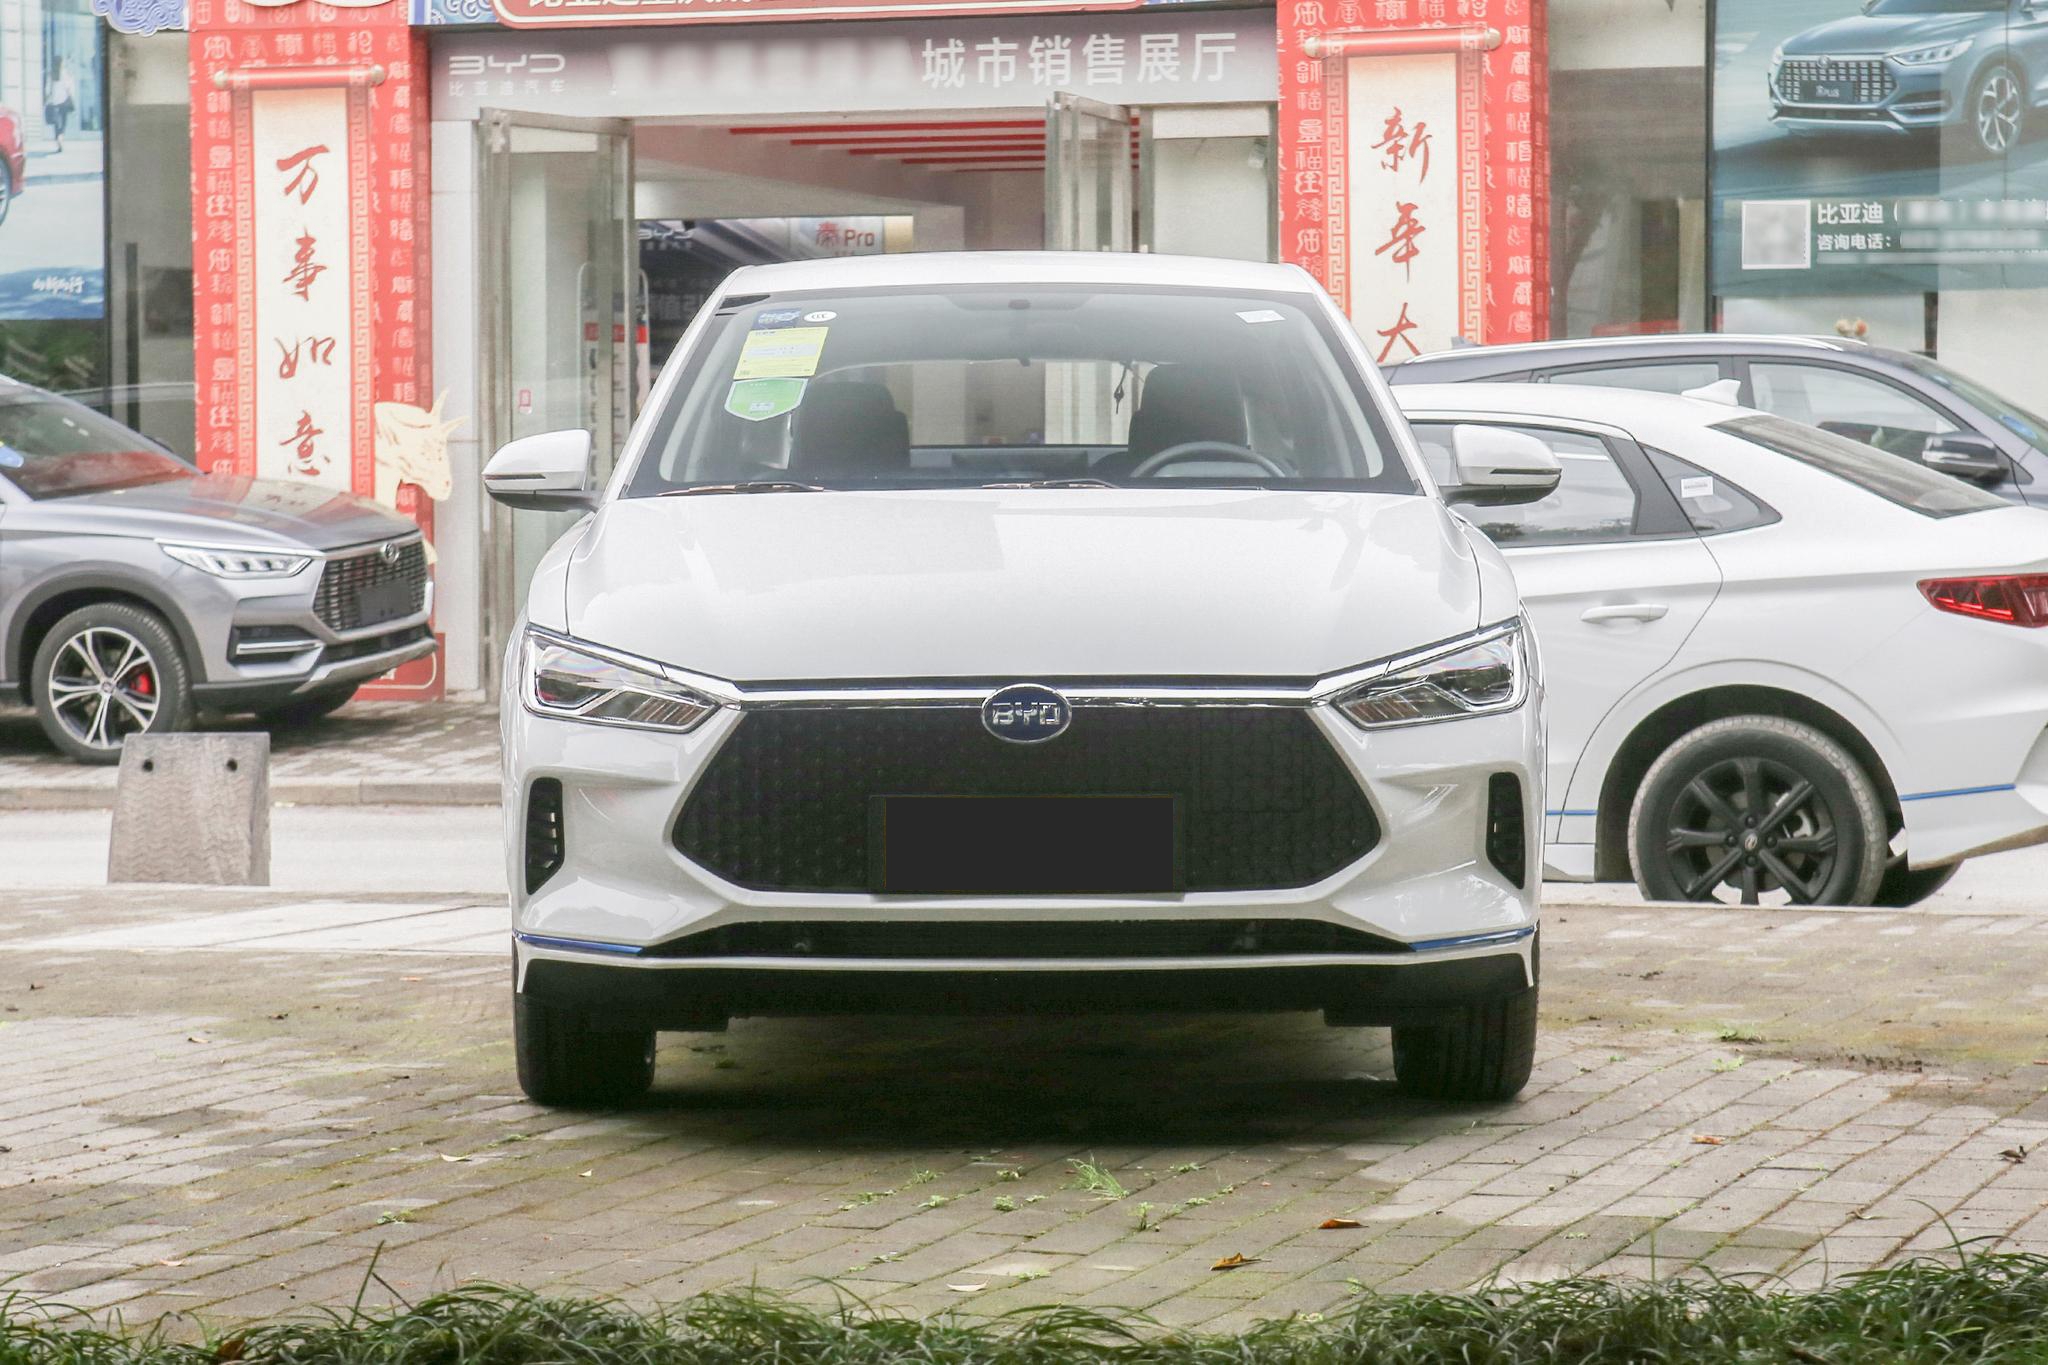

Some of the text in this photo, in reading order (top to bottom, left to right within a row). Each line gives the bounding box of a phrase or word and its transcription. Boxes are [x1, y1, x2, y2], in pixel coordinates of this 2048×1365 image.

[448, 54, 566, 75] BYD
[922, 33, 1237, 88] 城市销售展厅
[448, 79, 567, 97] 比亚迪汽车
[275, 144, 336, 476] 万事如意
[992, 702, 1060, 725] BYD
